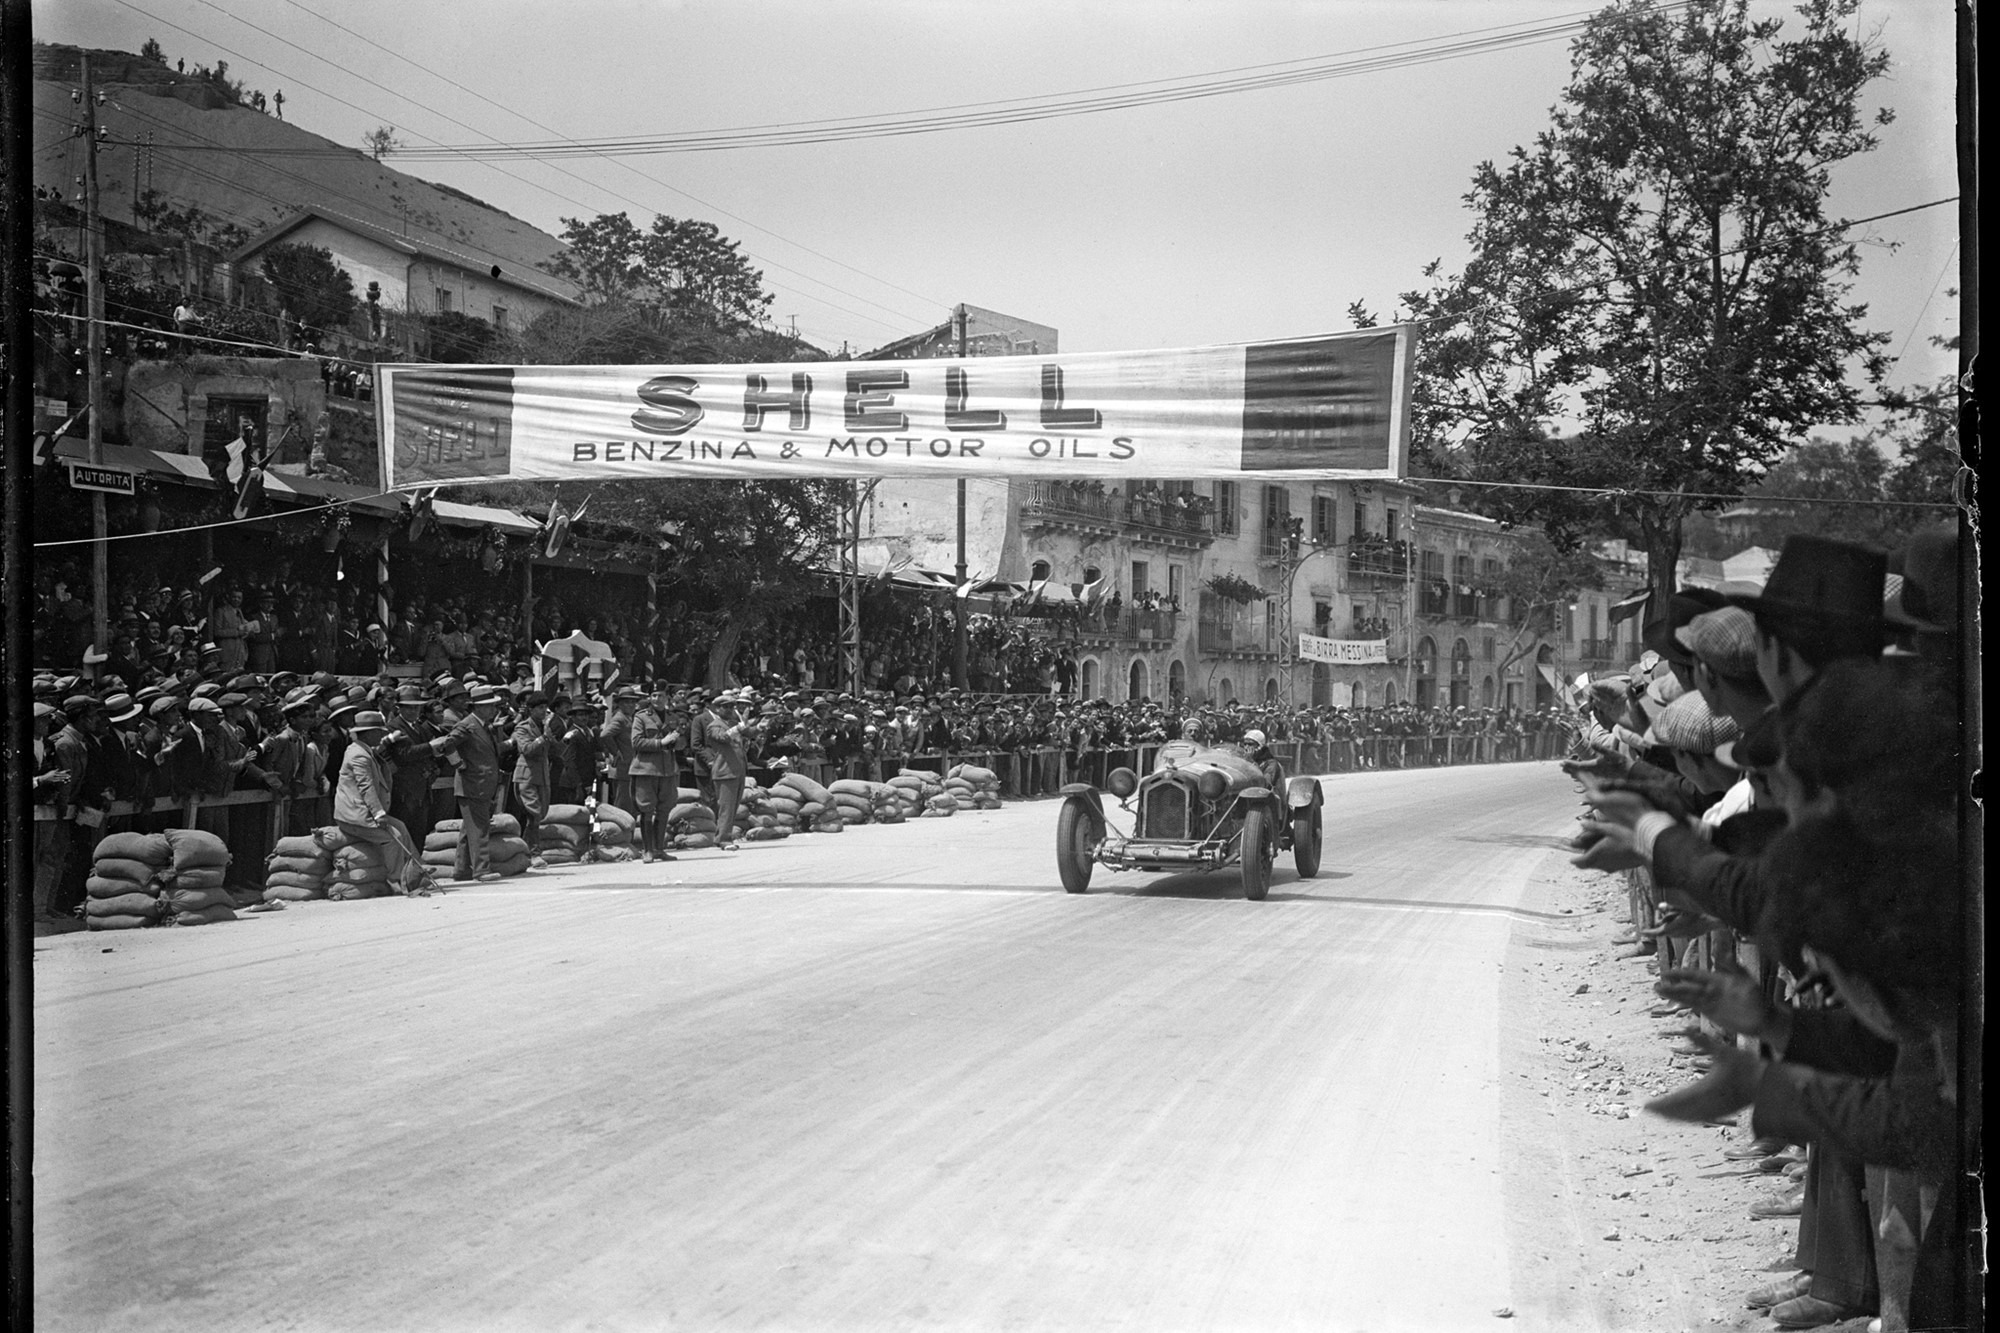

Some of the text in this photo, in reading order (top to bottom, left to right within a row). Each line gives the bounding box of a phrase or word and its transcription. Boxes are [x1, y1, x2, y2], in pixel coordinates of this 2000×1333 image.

[631, 365, 1101, 436] SHELL
[573, 436, 1136, 462] BENZINA & MOTOR OILS
[1316, 640, 1339, 658] BIRRA
[1340, 643, 1372, 660] MESSINA
